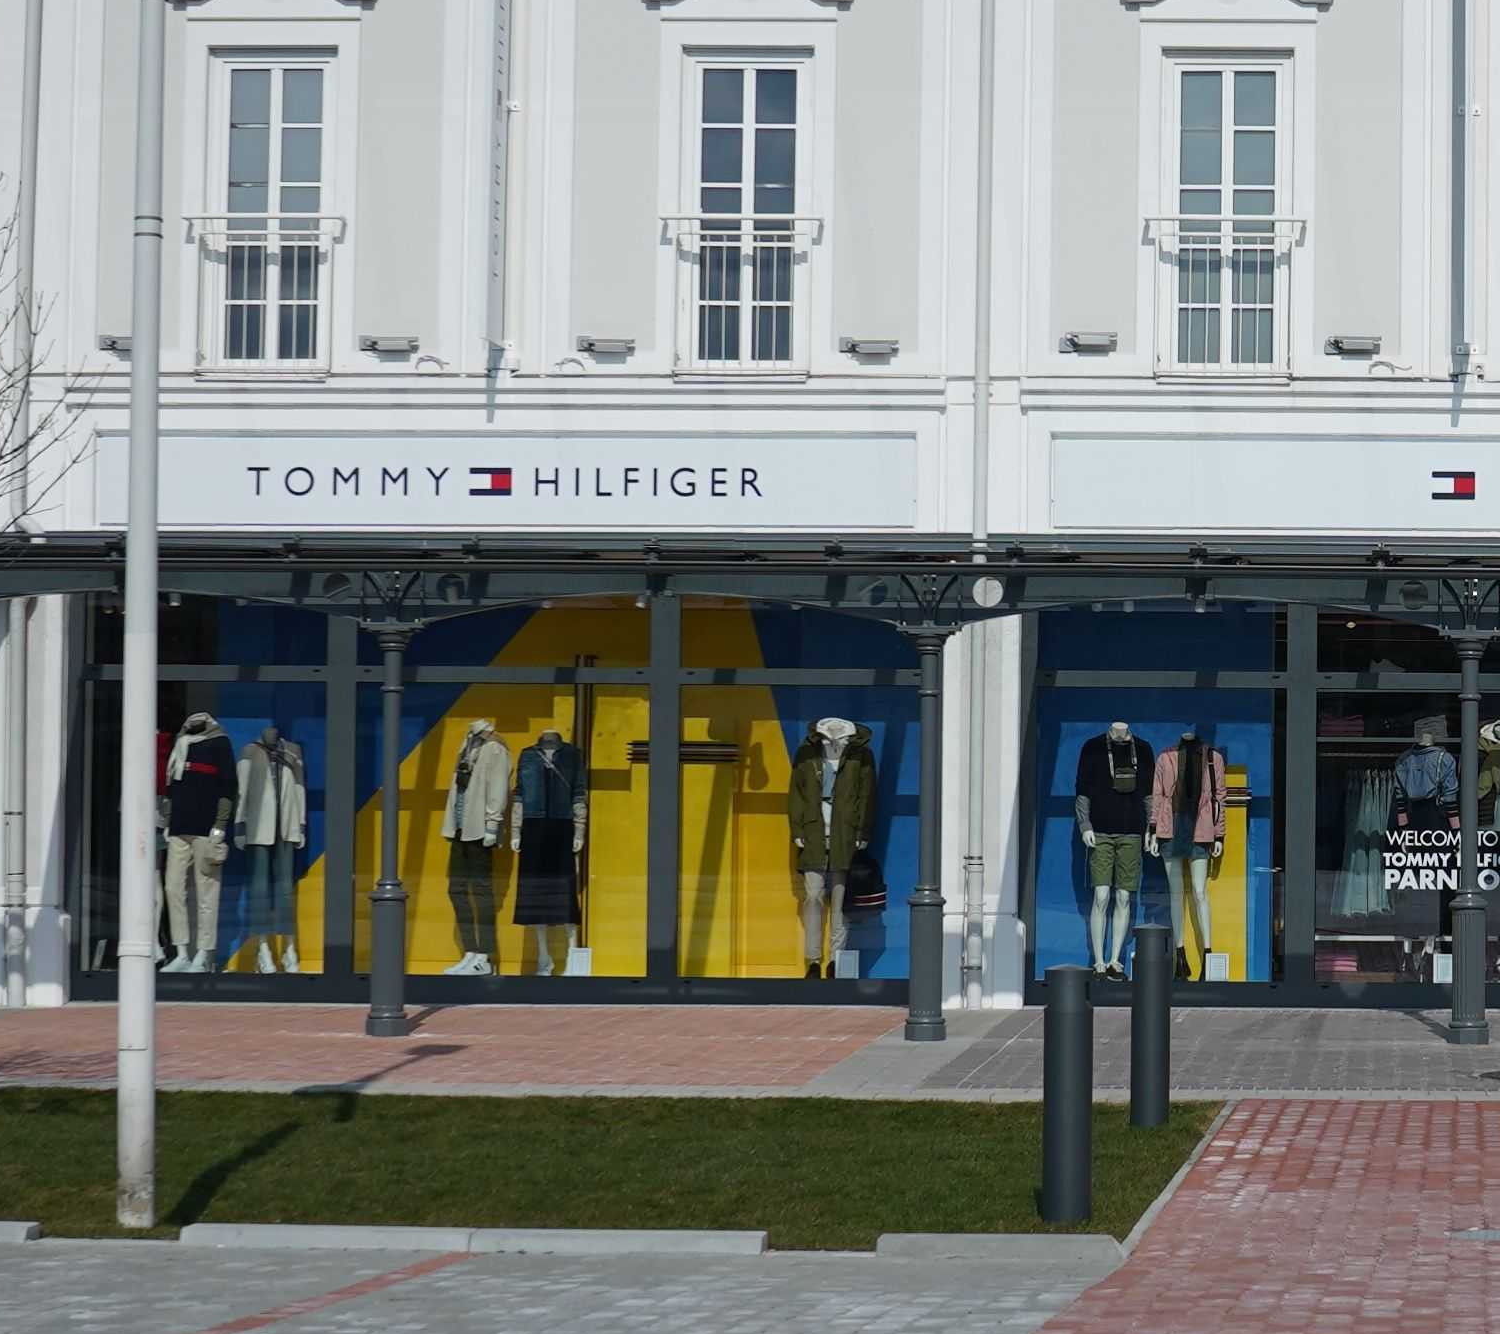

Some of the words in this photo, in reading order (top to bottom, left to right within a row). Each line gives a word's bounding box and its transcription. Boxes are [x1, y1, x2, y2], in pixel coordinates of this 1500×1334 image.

[246, 466, 450, 497] TOMMY
[534, 466, 765, 498] HILFIGER
[1386, 830, 1461, 847] WELCOM
[1476, 830, 1499, 847] TO
[1383, 852, 1451, 867] TOMMY
